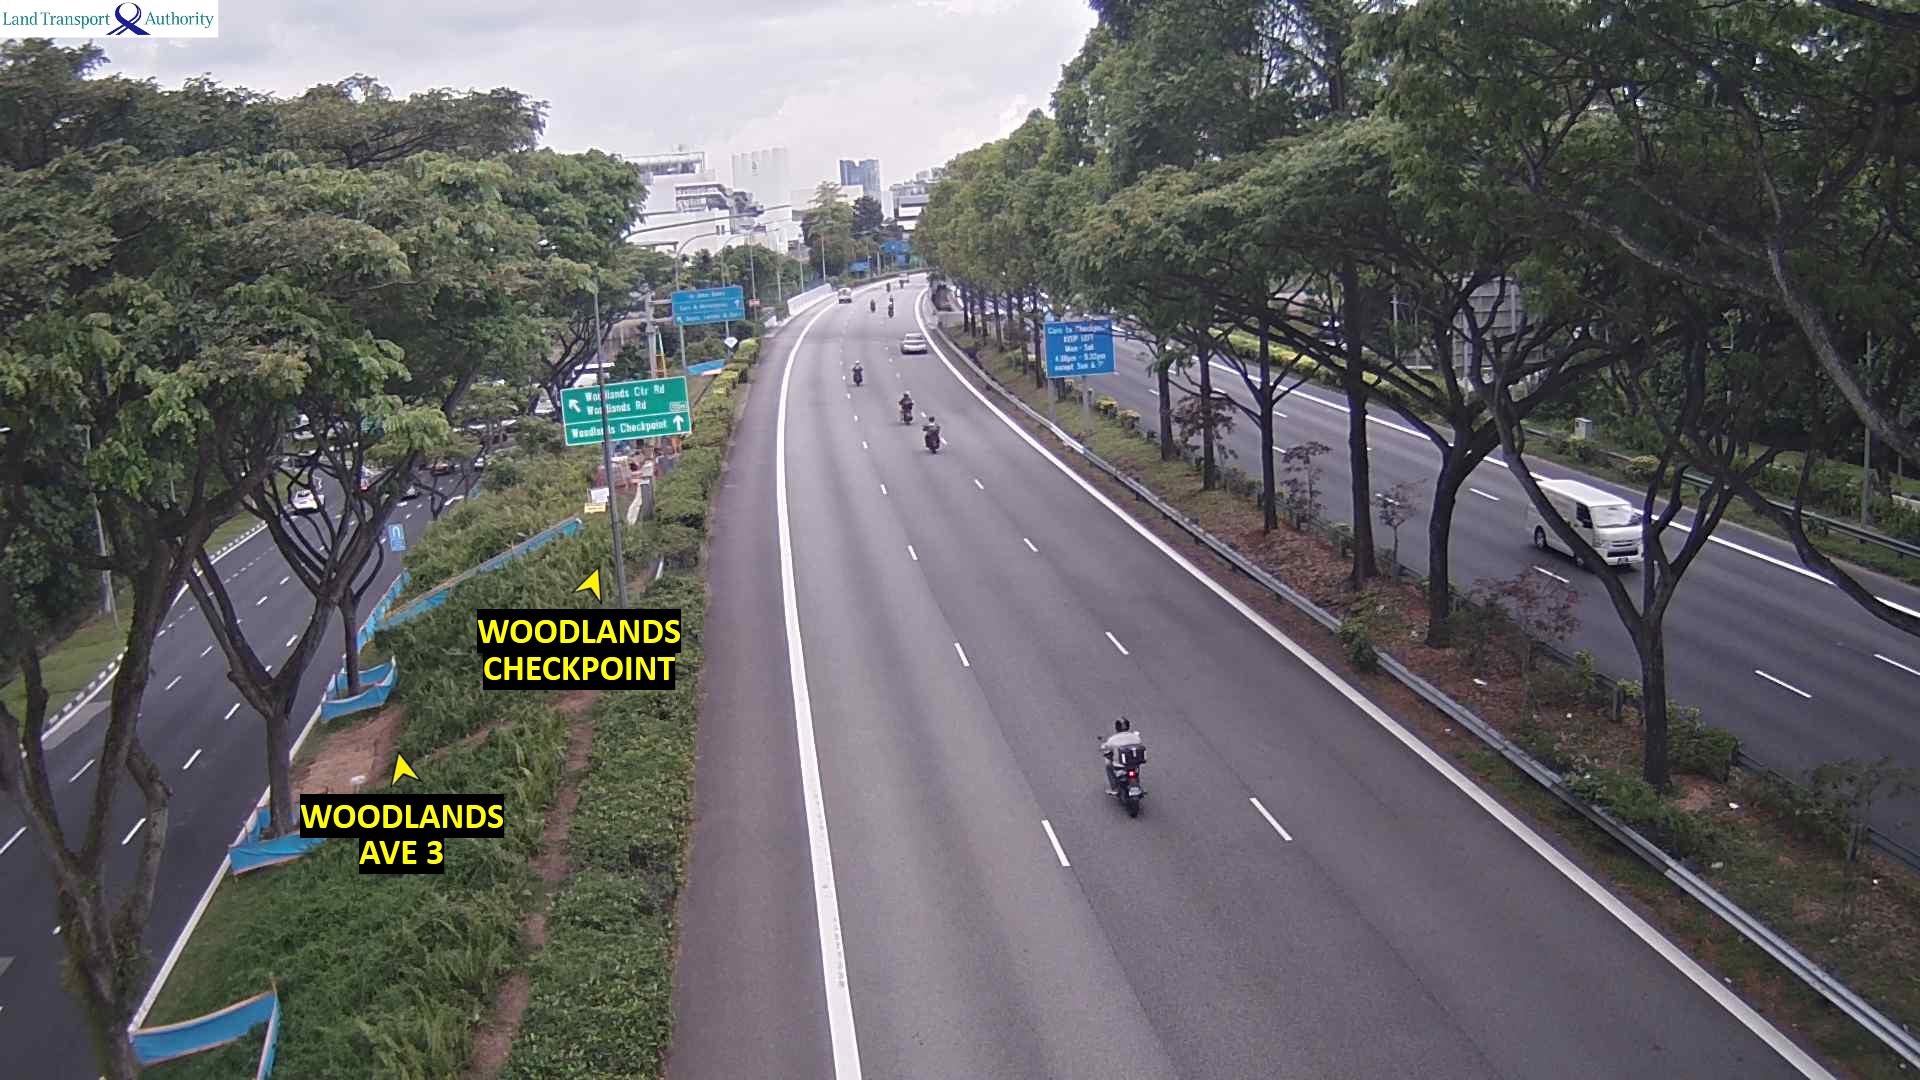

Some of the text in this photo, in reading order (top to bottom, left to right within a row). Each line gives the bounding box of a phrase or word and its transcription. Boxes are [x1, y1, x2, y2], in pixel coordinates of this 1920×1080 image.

[633, 386, 648, 397] Ctr
[653, 384, 665, 394] Rd
[635, 400, 647, 410] Rd
[620, 419, 667, 433] Checkpoint
